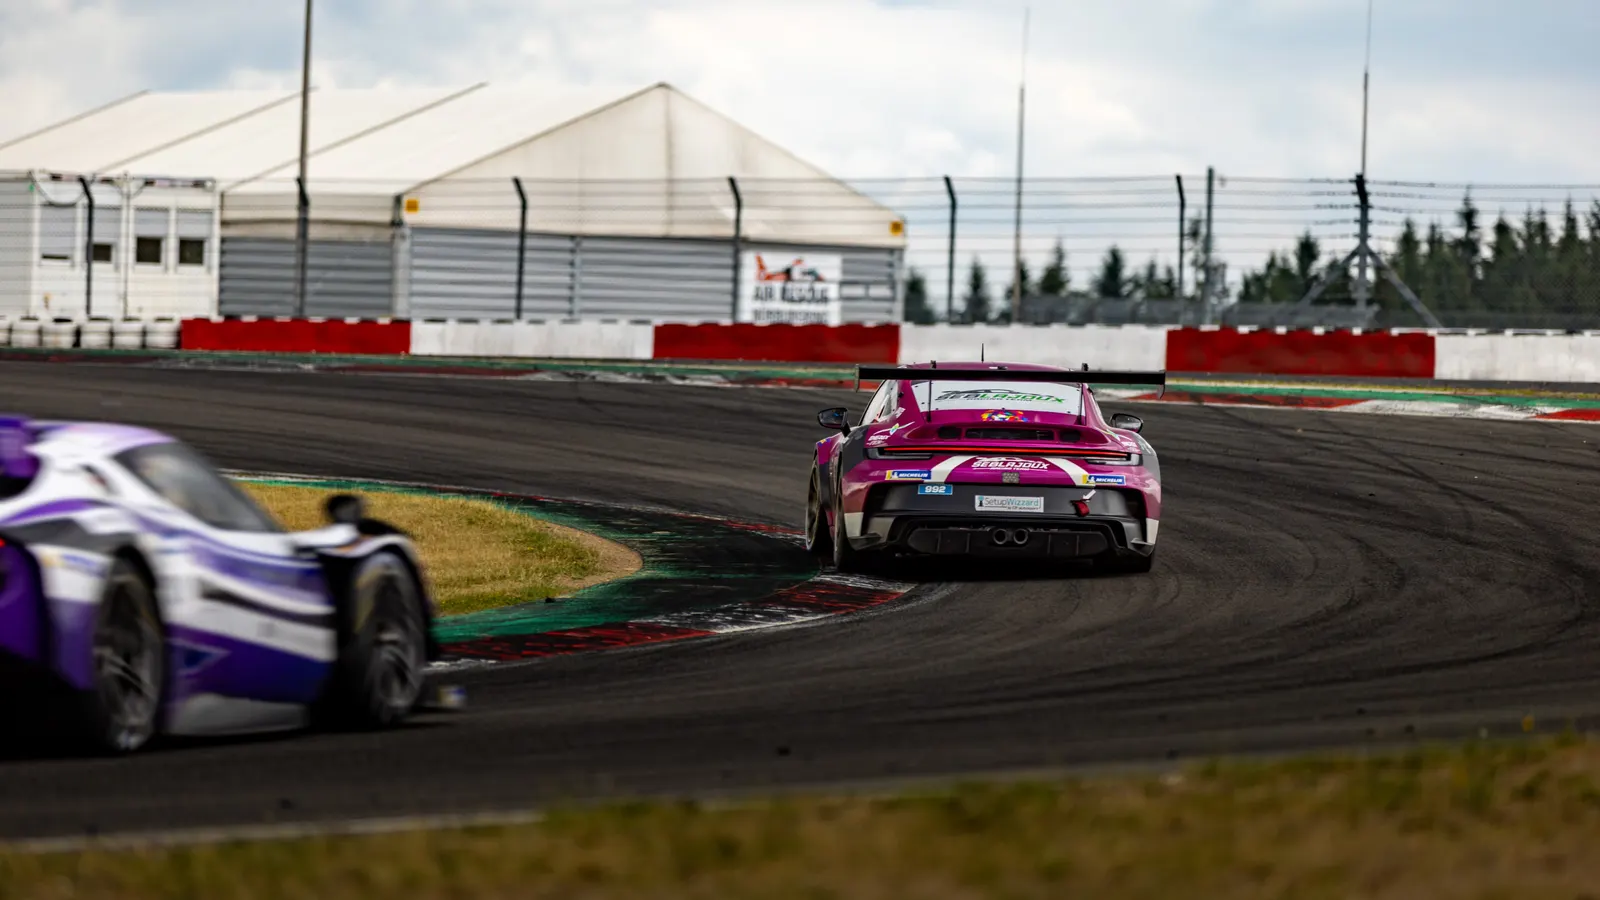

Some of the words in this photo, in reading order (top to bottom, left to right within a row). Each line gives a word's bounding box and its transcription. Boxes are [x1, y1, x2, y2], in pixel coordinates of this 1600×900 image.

[754, 285, 774, 301] AIR
[971, 460, 1050, 470] SEBLAJOUX
[924, 485, 947, 493] 992
[984, 497, 1039, 508] SetupWizzard
